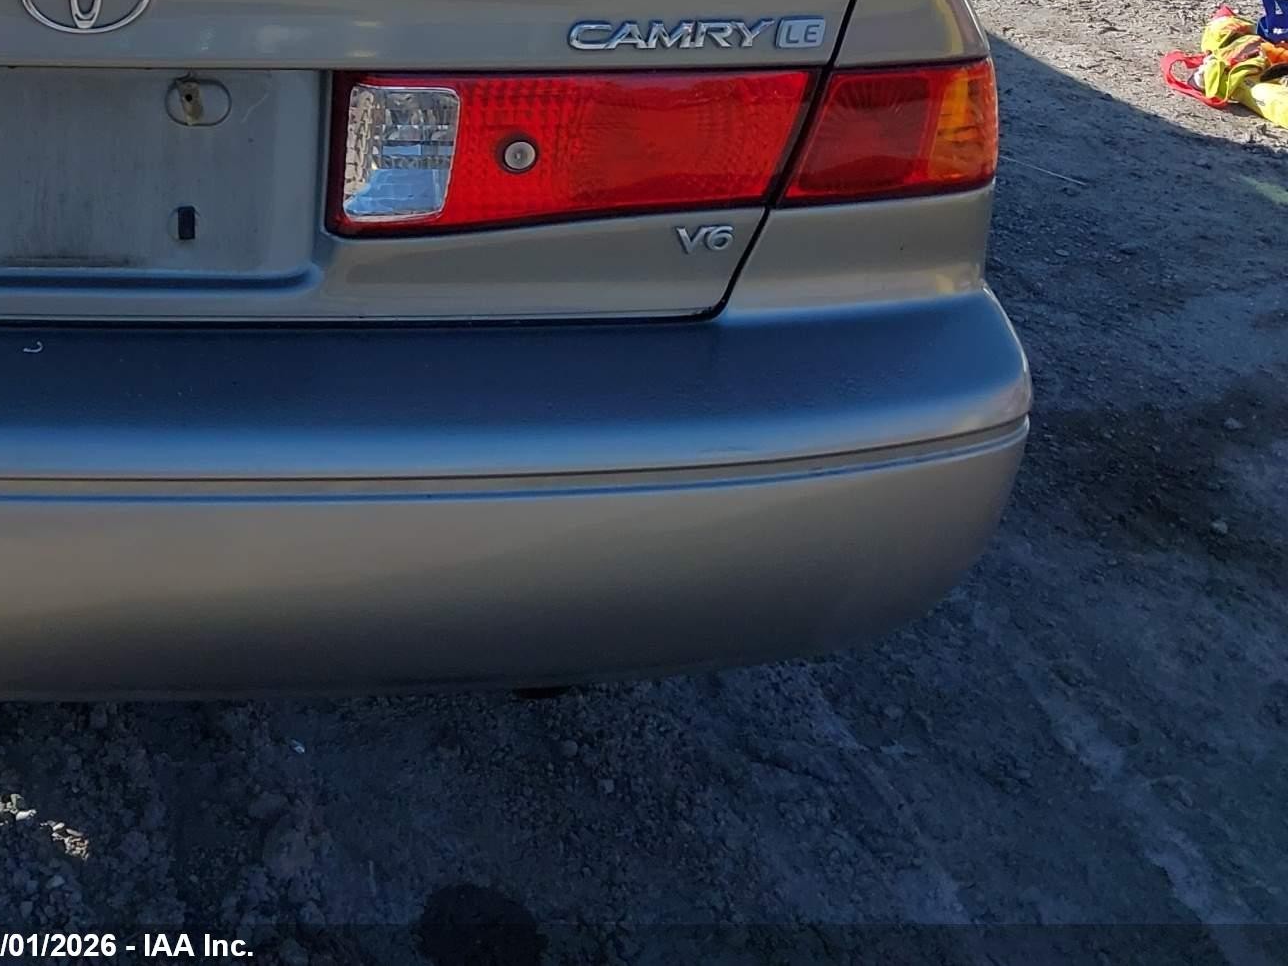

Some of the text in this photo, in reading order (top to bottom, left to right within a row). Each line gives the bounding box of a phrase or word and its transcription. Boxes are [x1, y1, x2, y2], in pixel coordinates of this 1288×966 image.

[568, 18, 821, 50] CAMRY LE
[676, 225, 734, 253] V6
